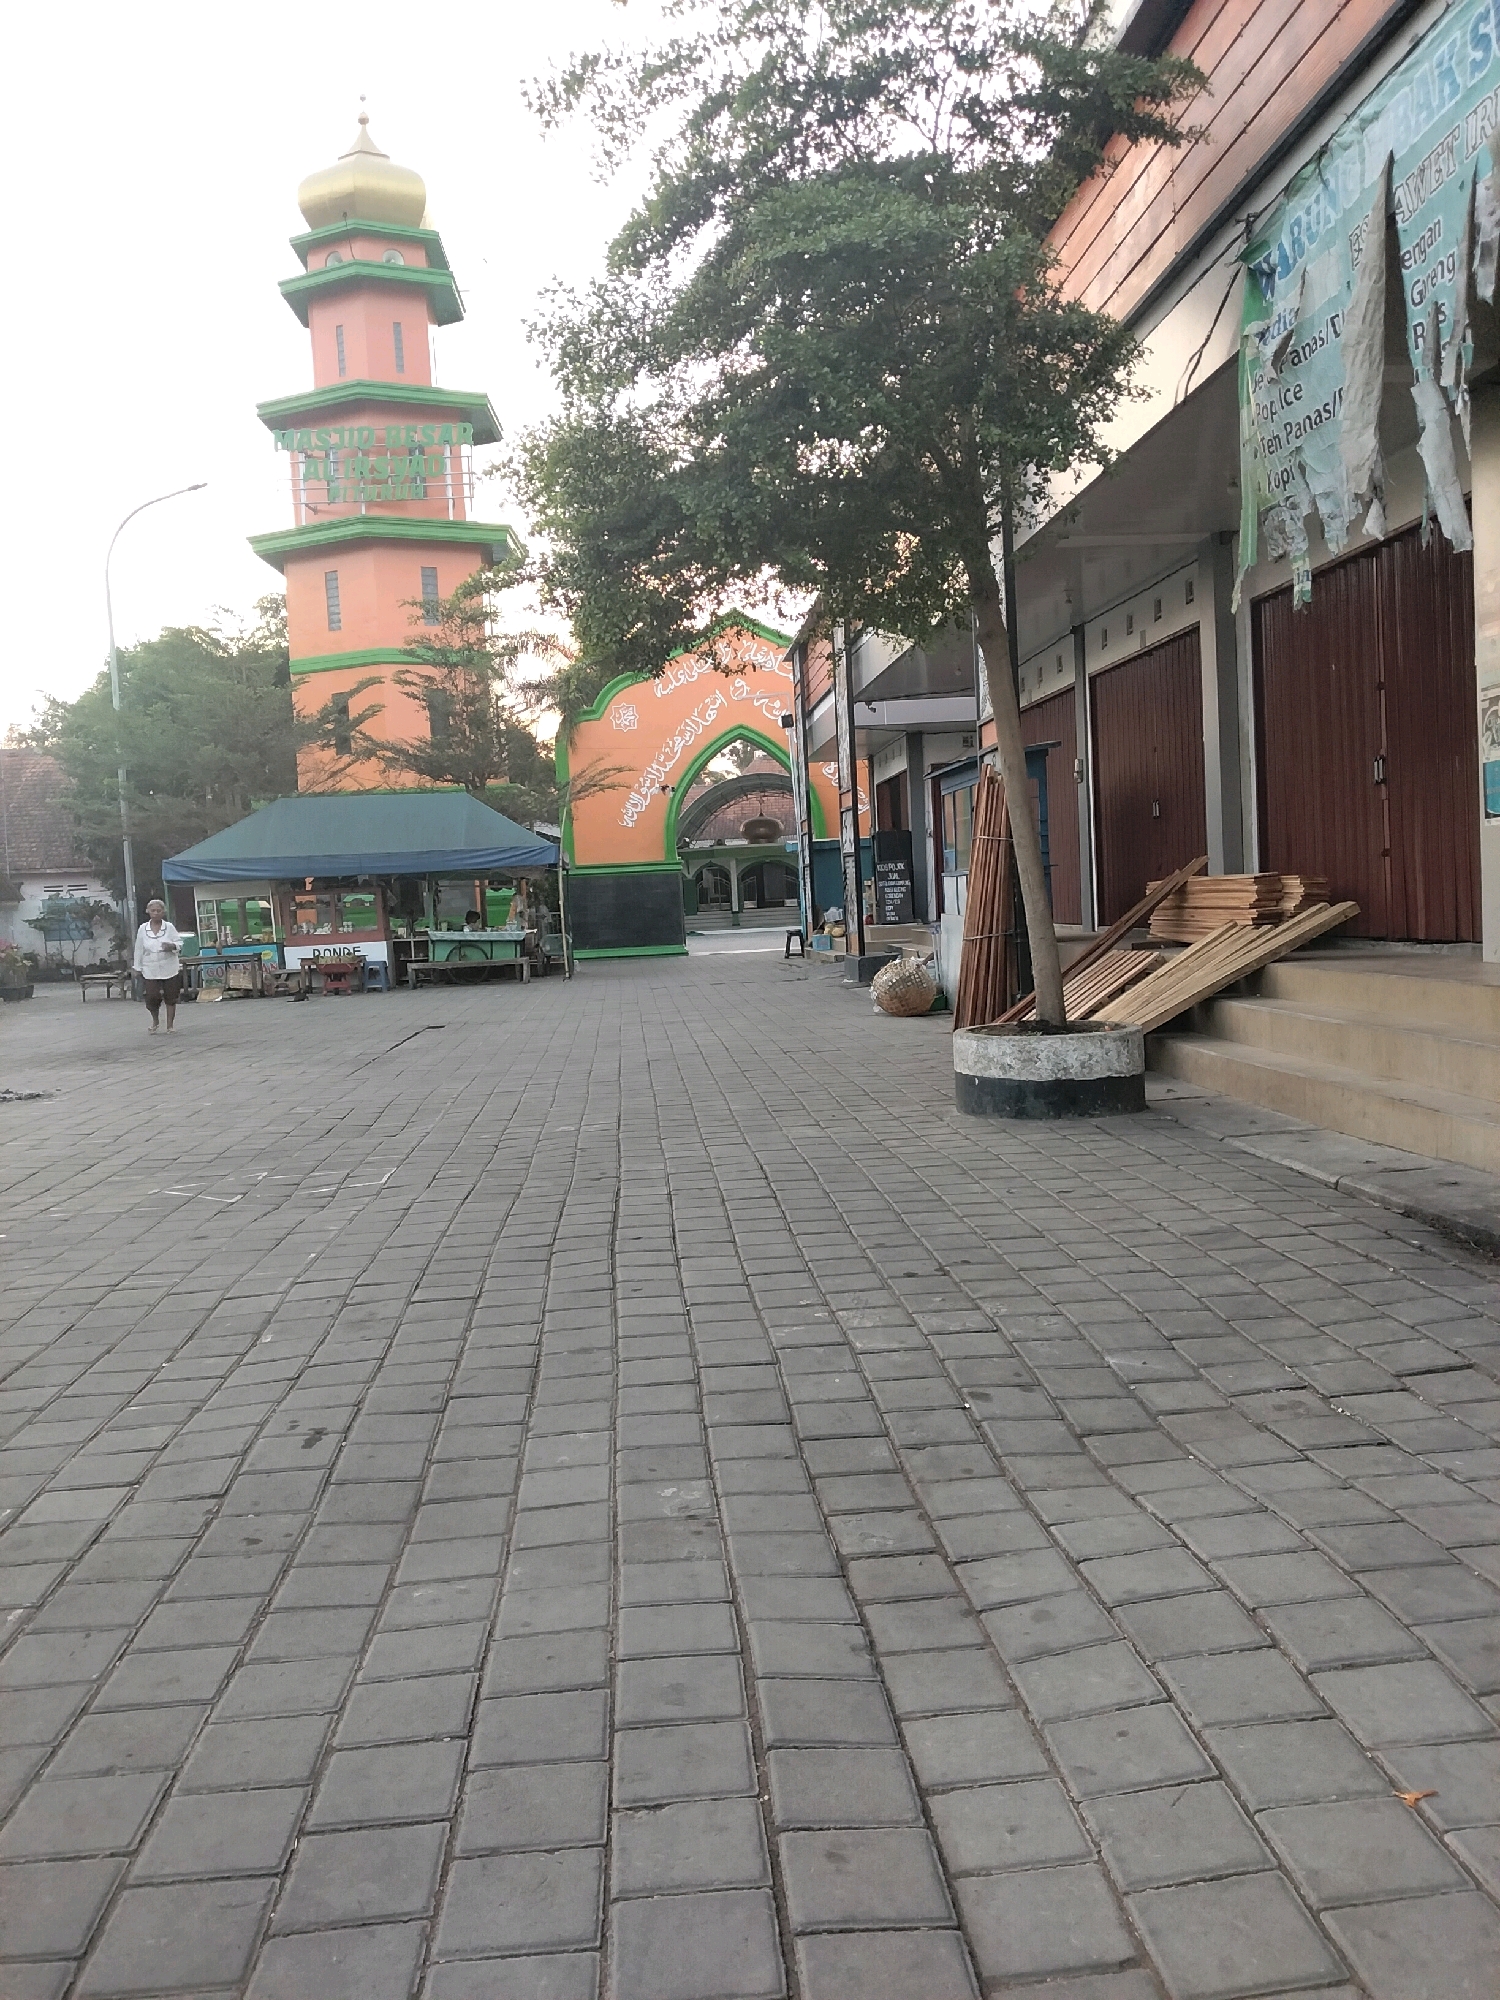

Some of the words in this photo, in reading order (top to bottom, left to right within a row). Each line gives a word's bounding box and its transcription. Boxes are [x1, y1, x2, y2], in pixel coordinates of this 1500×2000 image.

[1468, 0, 1500, 87] S
[1411, 251, 1456, 307] Goreng
[1256, 399, 1277, 425] Pop
[1279, 382, 1303, 410] Ice
[271, 425, 375, 452] MASJID
[384, 422, 474, 449] BESAR
[1260, 430, 1282, 458] Teh
[303, 457, 337, 482] AL
[343, 454, 446, 483] IRSYAD
[1267, 459, 1295, 493] Kopi
[328, 482, 425, 503] PITURUH
